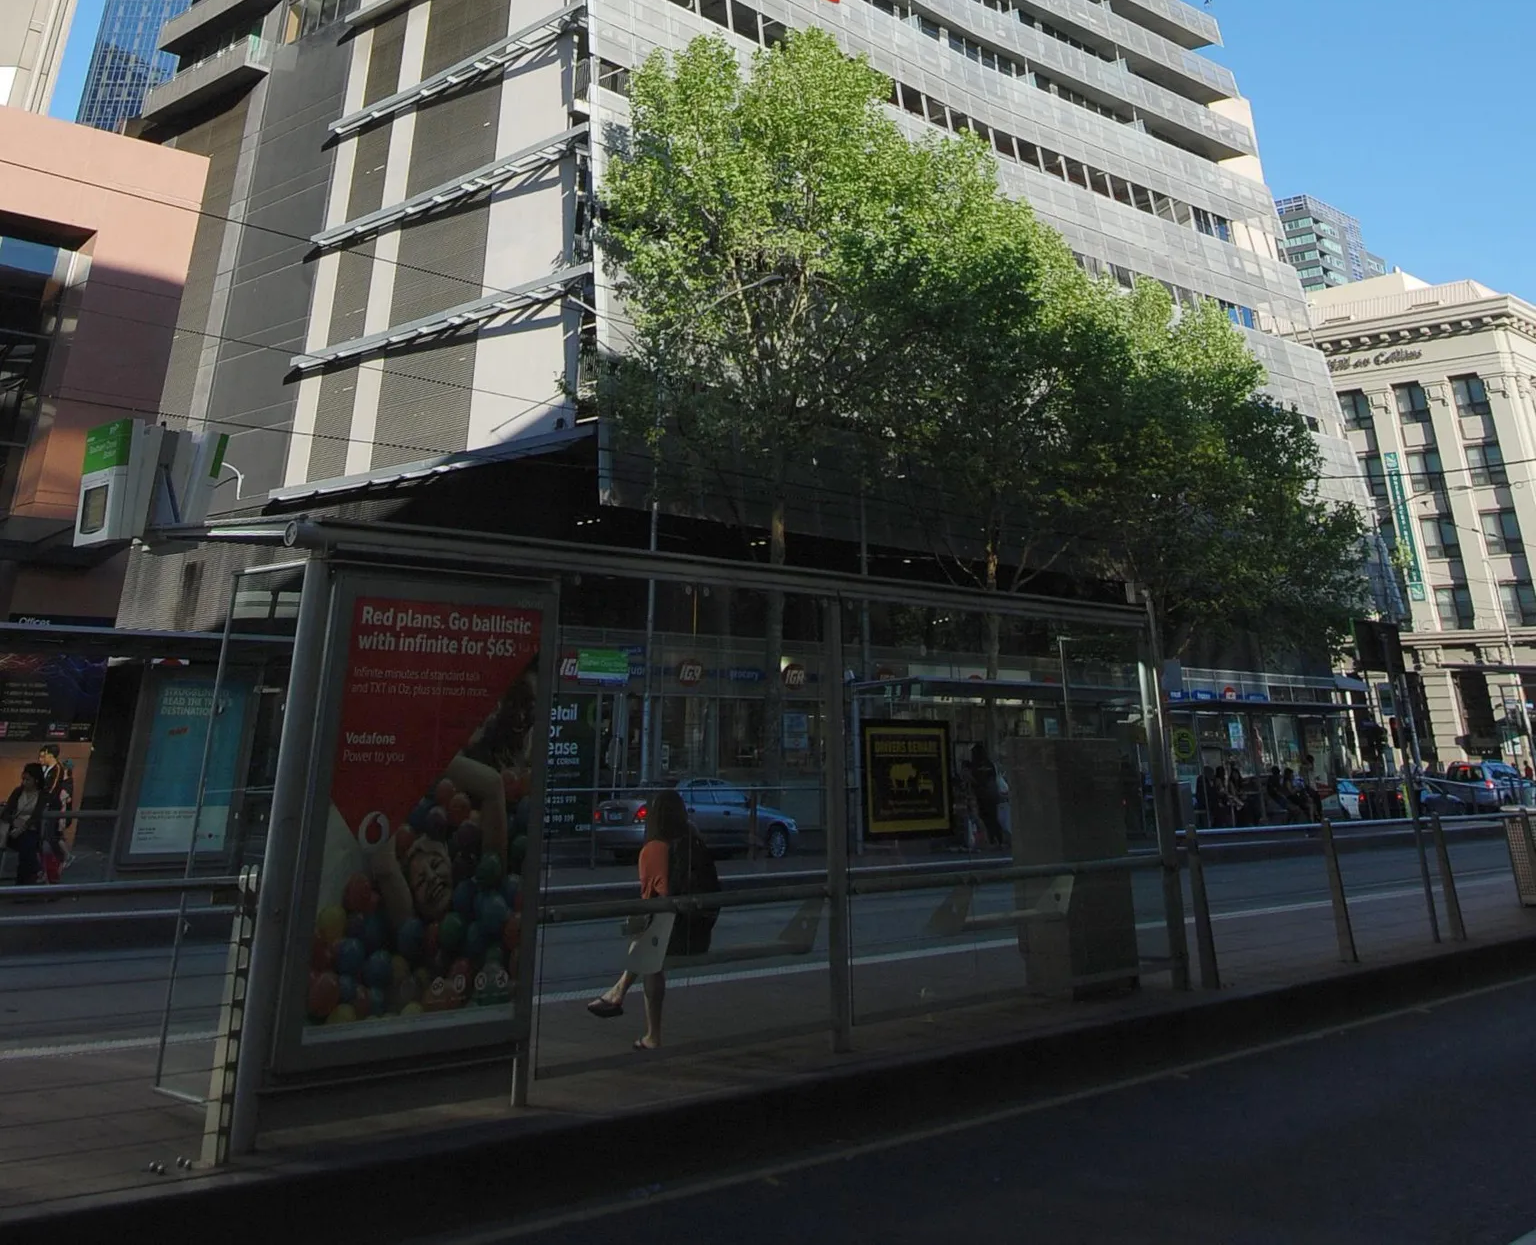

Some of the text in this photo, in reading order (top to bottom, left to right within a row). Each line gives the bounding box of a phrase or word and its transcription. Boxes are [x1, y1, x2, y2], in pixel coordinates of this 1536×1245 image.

[361, 606, 532, 634] Red plans. Go ballistic
[358, 632, 517, 659] with infinite for $65.
[353, 667, 384, 678] Infinite
[560, 658, 578, 676] IG
[785, 670, 806, 684] IGA
[351, 682, 368, 693] and
[370, 682, 386, 693] TXT
[388, 683, 396, 693] in
[413, 684, 431, 697] plus
[431, 687, 441, 696] so
[442, 686, 465, 697] much
[161, 706, 212, 716] DESTINATIO
[550, 703, 578, 721] etail
[346, 731, 396, 745] Vodafone
[548, 741, 578, 755] ease
[343, 749, 405, 765] Power to you
